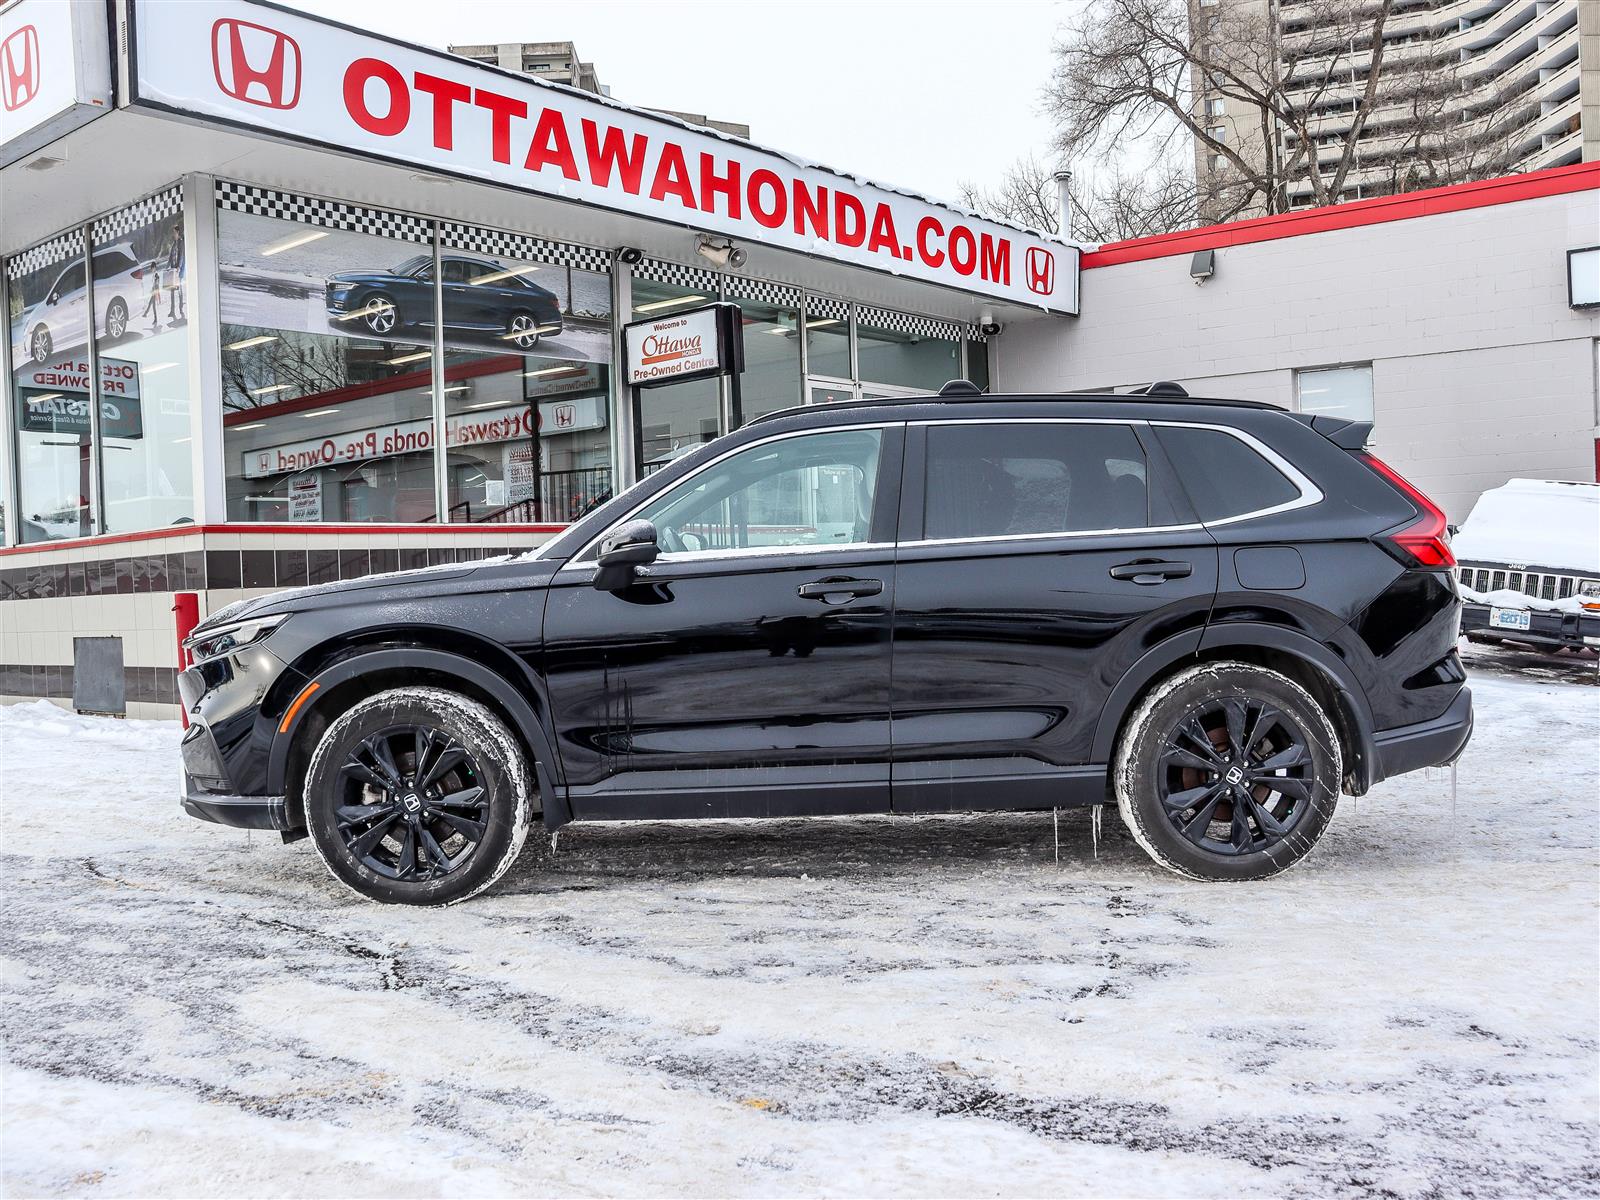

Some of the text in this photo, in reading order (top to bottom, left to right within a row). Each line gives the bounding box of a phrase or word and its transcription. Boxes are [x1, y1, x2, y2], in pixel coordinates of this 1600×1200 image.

[343, 57, 1011, 286] OTTAWAHONDA.COM
[653, 321, 680, 331] Welcome
[642, 335, 701, 357] Ottawa
[634, 358, 714, 380] Pre-Owned Centre
[1508, 563, 1527, 571] Jeep
